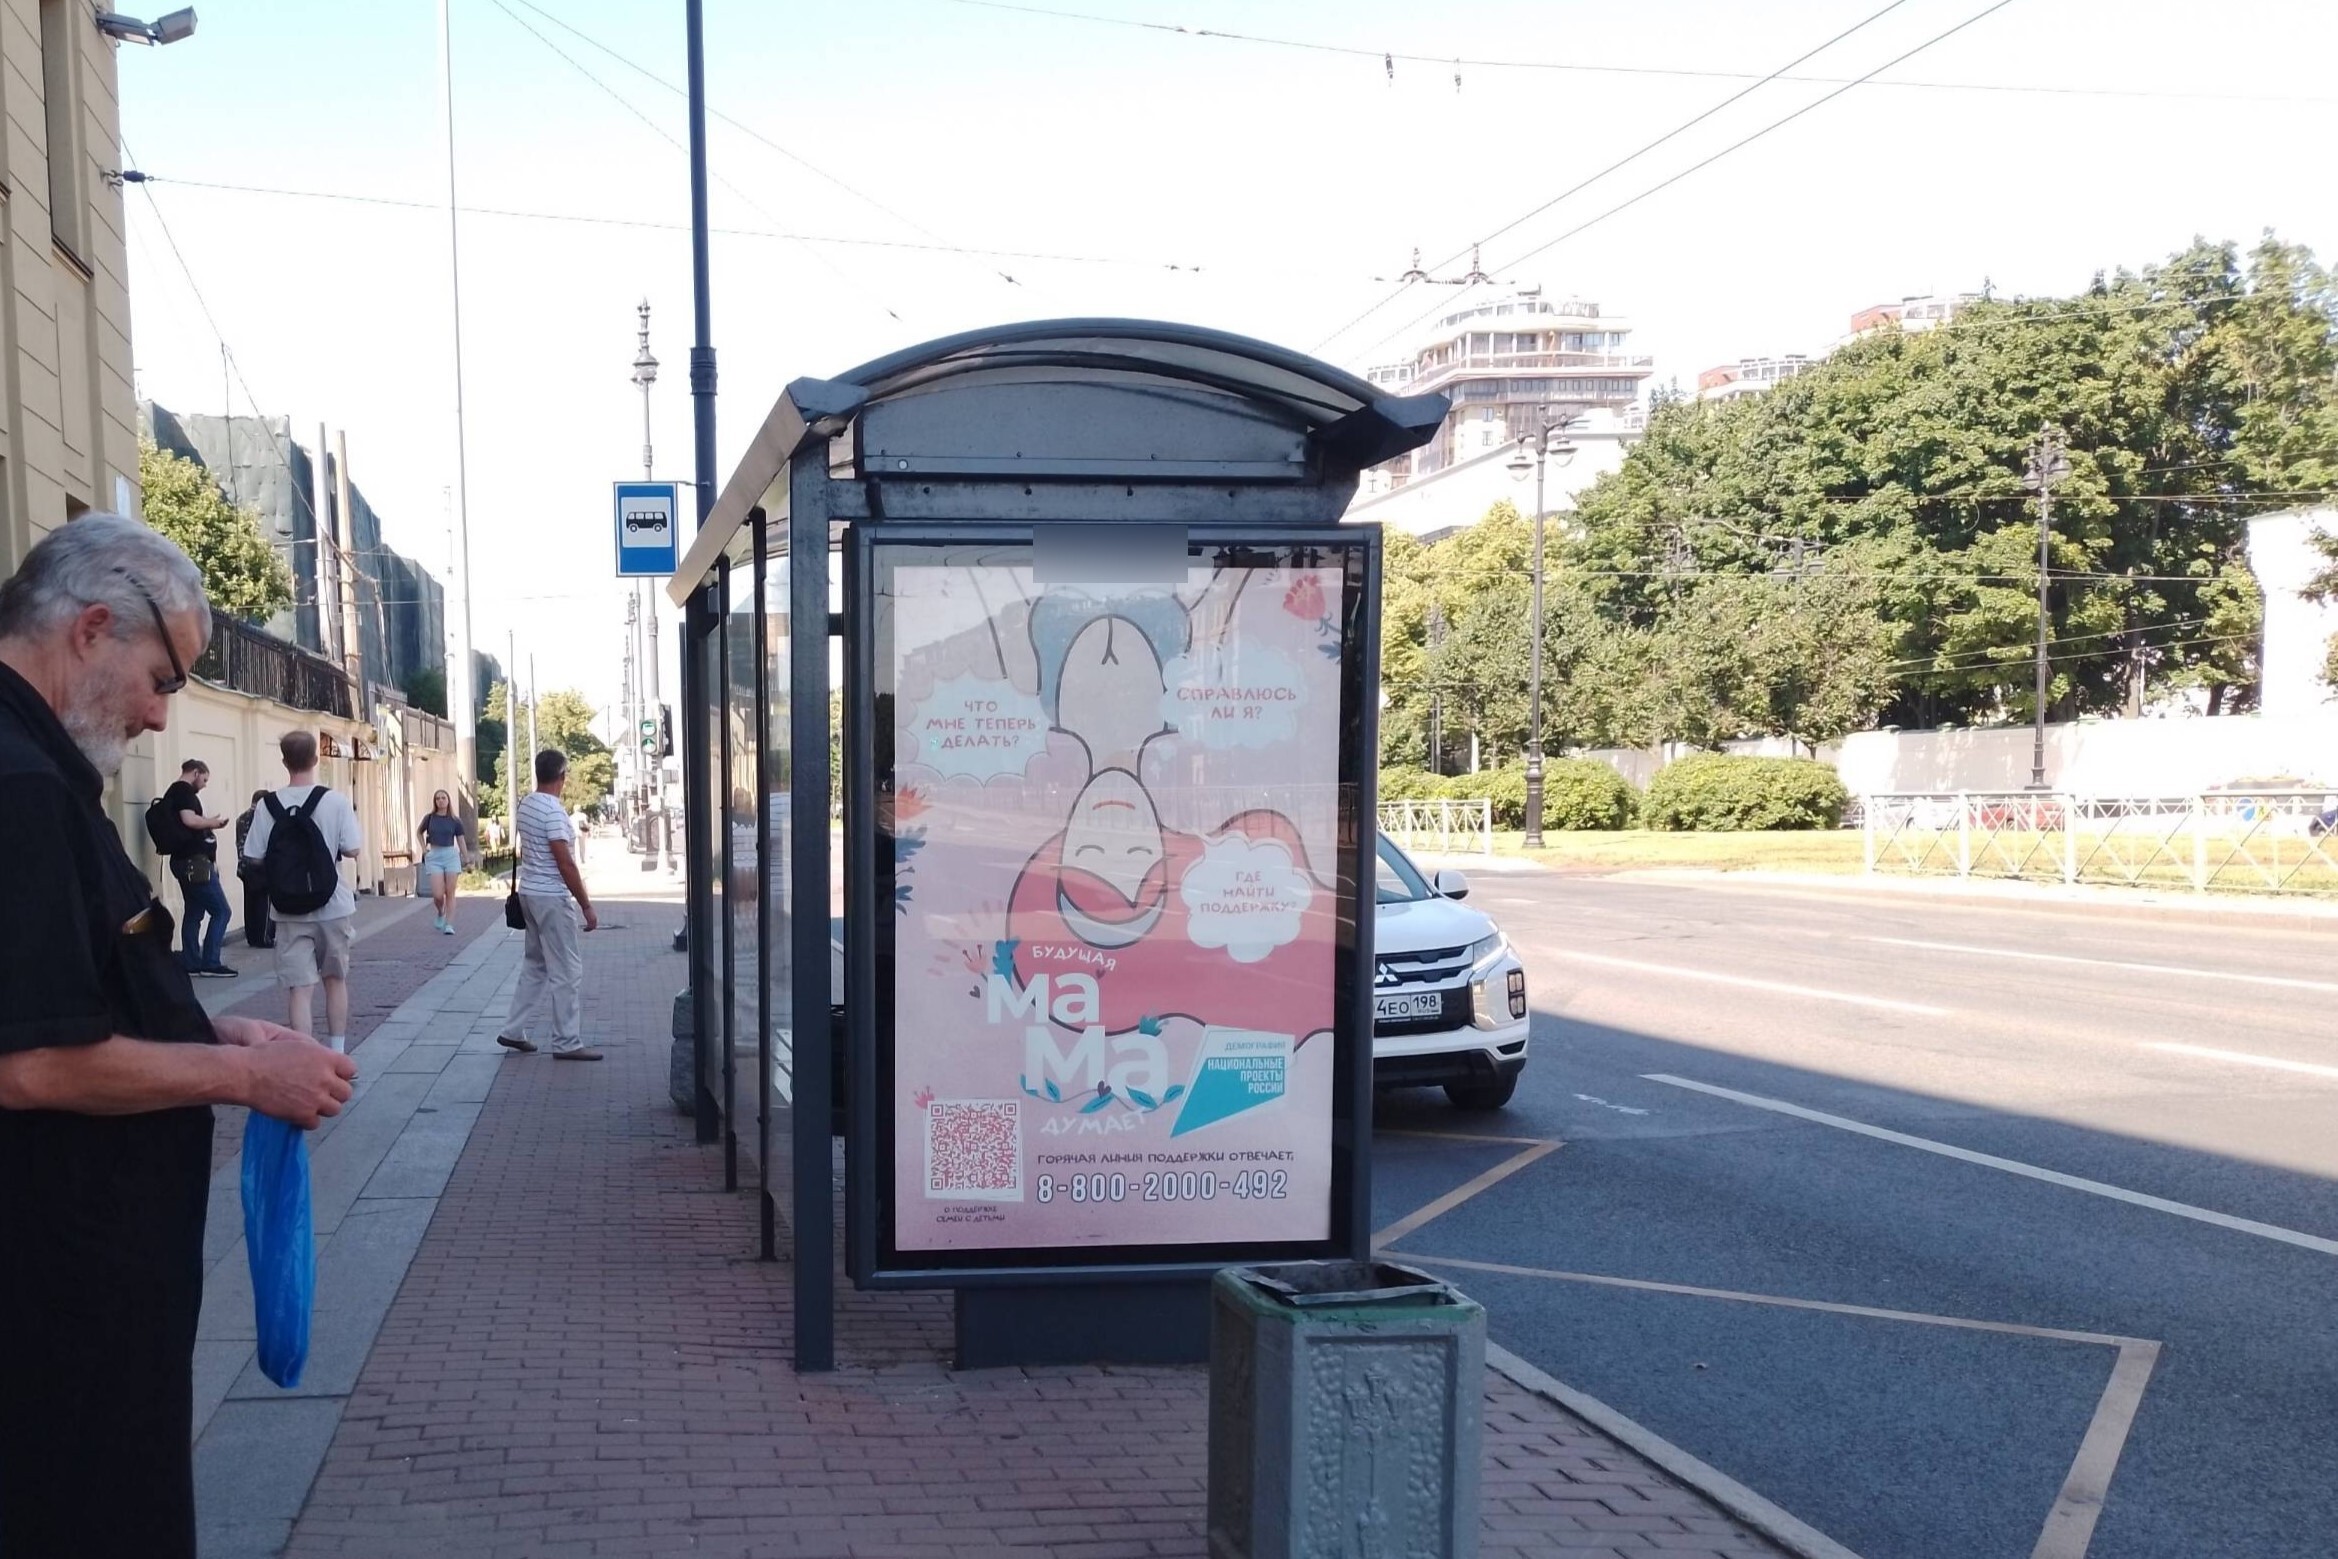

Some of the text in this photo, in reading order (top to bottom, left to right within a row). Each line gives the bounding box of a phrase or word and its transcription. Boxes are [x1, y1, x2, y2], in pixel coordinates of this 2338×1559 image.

[1176, 686, 1297, 701] СПРАВЛЮСЬ
[963, 699, 998, 713] ЧТО
[1210, 704, 1264, 720] ЛИ Я?
[925, 716, 1037, 731] МНЕ ТЕПЕРЬ
[940, 734, 1020, 750] ДЕЛАТЬ?
[1235, 871, 1263, 884] ГДЕ
[1222, 884, 1275, 898] НАЙТИ
[1200, 900, 1298, 915] ПОДДЕРЖКУ?
[1031, 945, 1117, 972] БУДУЩАЯ
[1412, 994, 1438, 1009] 198
[1207, 1057, 1284, 1071] НАЦИОНАЛЬНЫЕ
[1240, 1069, 1284, 1083] ПРОЕКТЫ
[1247, 1081, 1284, 1094] РОССИИ
[1040, 1108, 1146, 1136] ДУМАЕТ
[1037, 1153, 1096, 1165] ГОРЯЧАЯ
[1101, 1152, 1143, 1163] ЛИНИЯ
[1148, 1150, 1225, 1164] ПОДДЕРЖКИ
[1036, 1169, 1289, 1204] 8-800-2000-492
